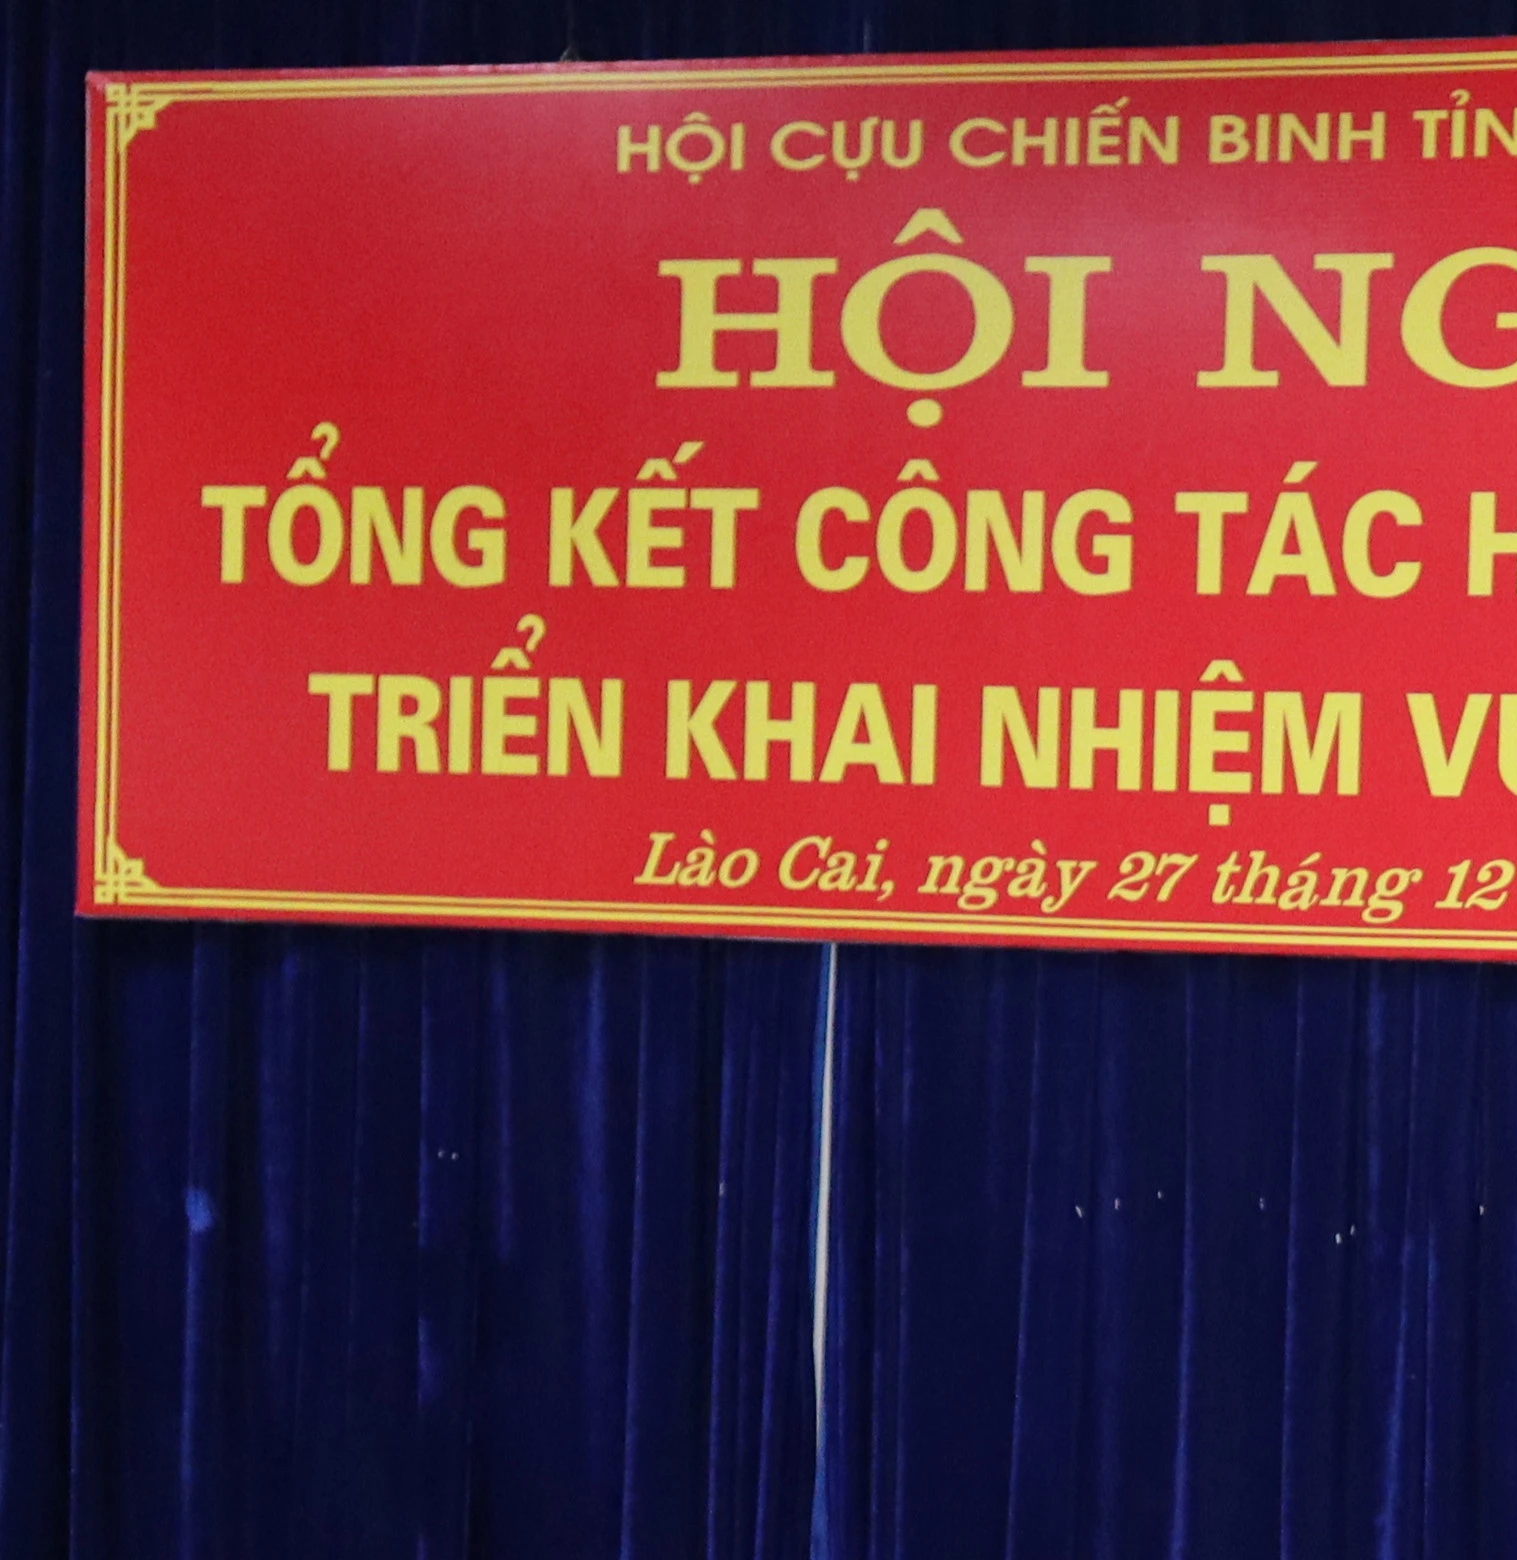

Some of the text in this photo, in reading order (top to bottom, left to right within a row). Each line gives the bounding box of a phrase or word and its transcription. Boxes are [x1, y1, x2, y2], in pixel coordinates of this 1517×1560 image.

[616, 111, 746, 185] HỘI
[770, 116, 923, 182] CỰU
[948, 96, 1179, 168] CHIẾN
[1208, 111, 1386, 164] BINH
[655, 207, 1114, 428] HỘI
[201, 421, 507, 588] TỔNG
[548, 441, 760, 589] KẾT
[795, 458, 1134, 596] CÔNG
[1174, 460, 1424, 599] TÁC
[307, 613, 624, 778] TRIỂN
[665, 679, 938, 786] KHAI
[980, 659, 1363, 827] NHIỆM
[633, 828, 760, 889] Lào
[778, 835, 895, 902] Cai,
[917, 838, 1098, 914] ngày
[1107, 850, 1199, 902] 27
[1211, 849, 1424, 925] tháng
[1434, 858, 1516, 911] 12
